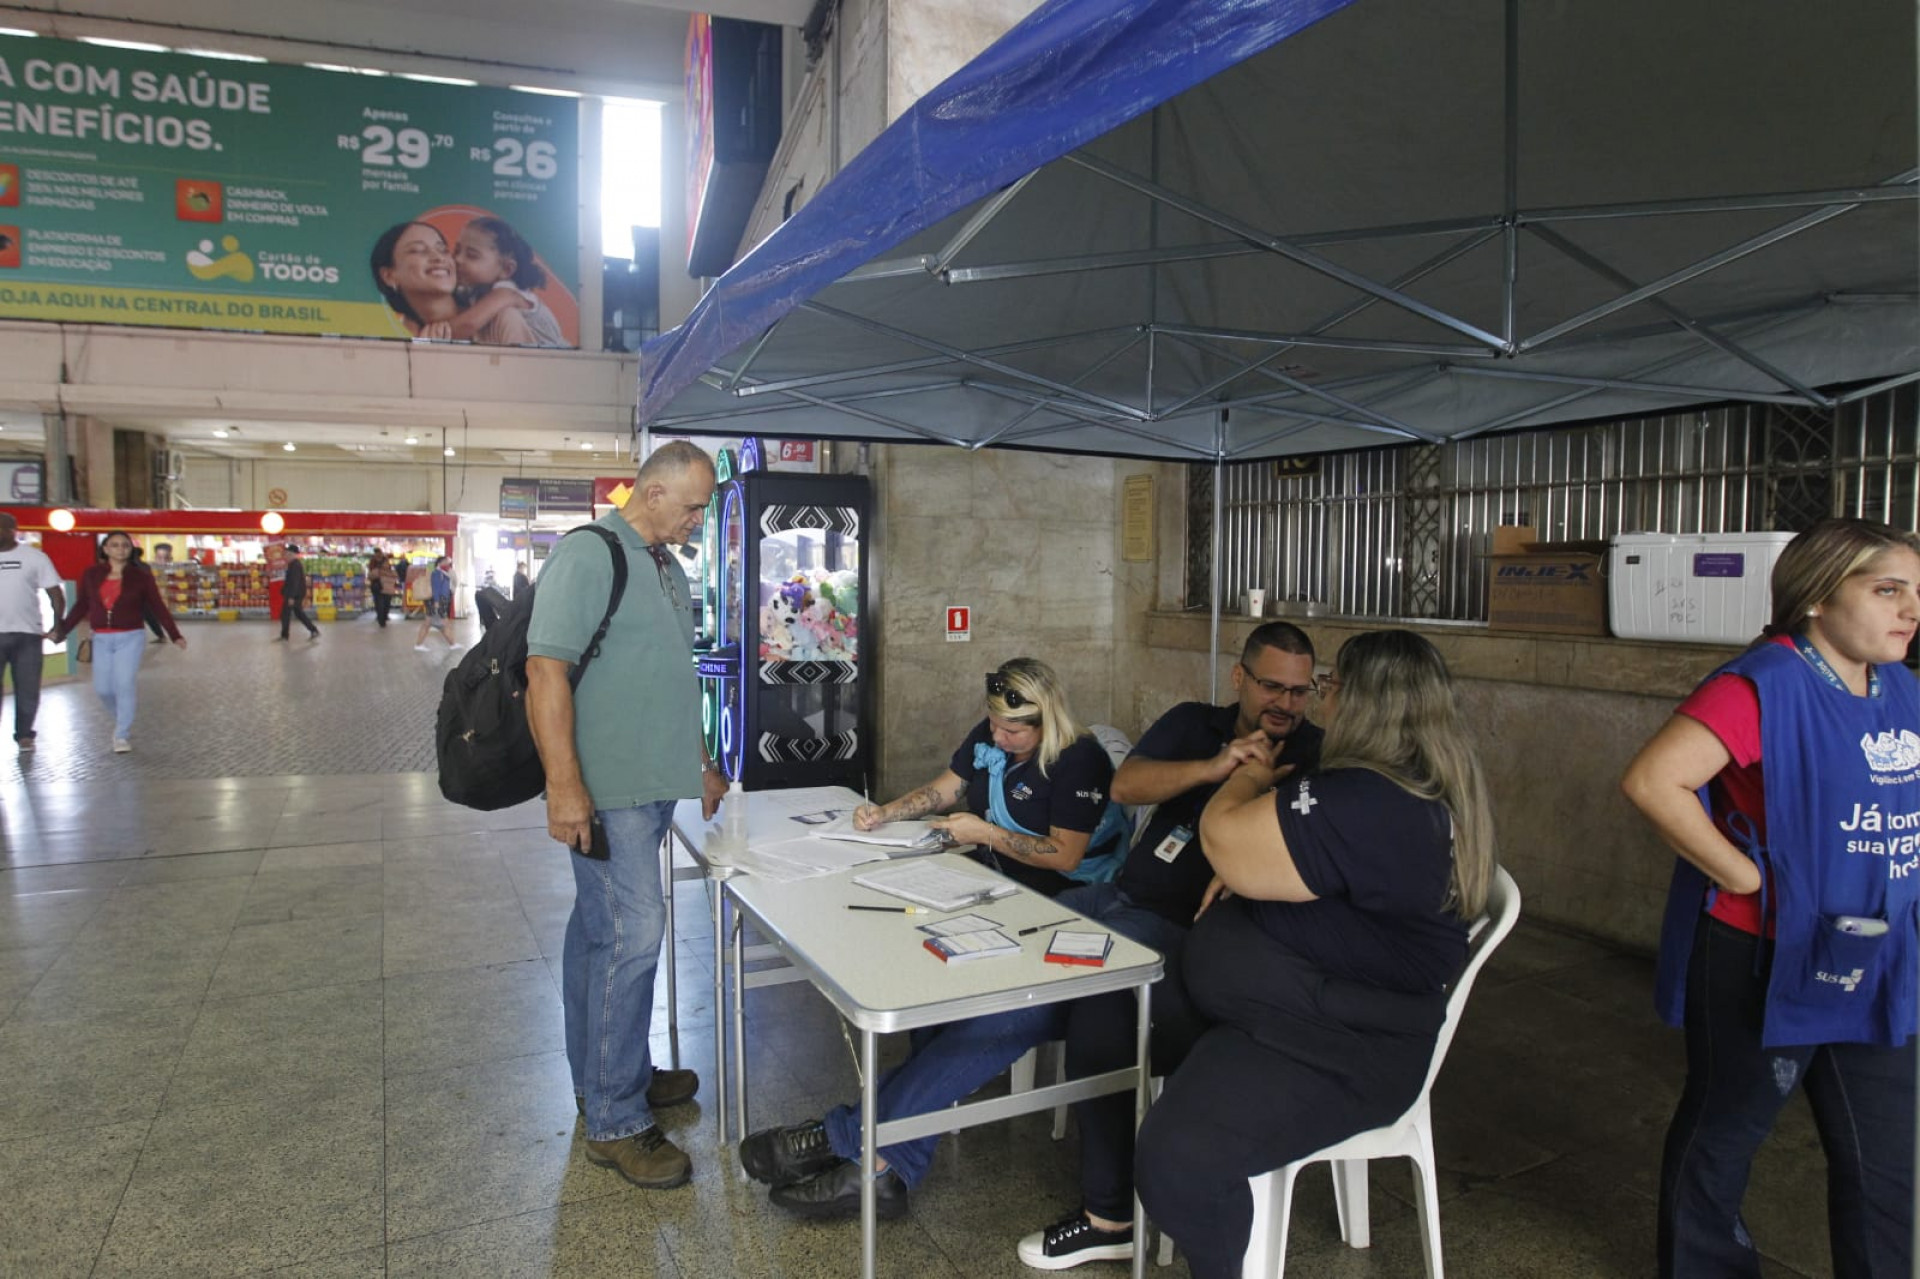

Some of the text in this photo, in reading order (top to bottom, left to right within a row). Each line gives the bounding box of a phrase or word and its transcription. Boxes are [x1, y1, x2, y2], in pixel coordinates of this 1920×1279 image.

[24, 59, 120, 98] COM
[131, 71, 271, 113] SAÚDE
[363, 107, 408, 122] Apenas
[337, 134, 359, 150] R$
[362, 125, 430, 169] 29
[470, 137, 557, 179] R$ 26
[295, 205, 329, 217] VOLTA
[259, 262, 340, 283] TODOS
[46, 291, 96, 308] AQUI
[100, 294, 129, 310] NA
[133, 297, 223, 317] CENTRAL
[227, 302, 254, 318] DO
[1497, 563, 1593, 581] INJEX
[1839, 803, 1882, 832] Já
[1847, 839, 1885, 856] sua
